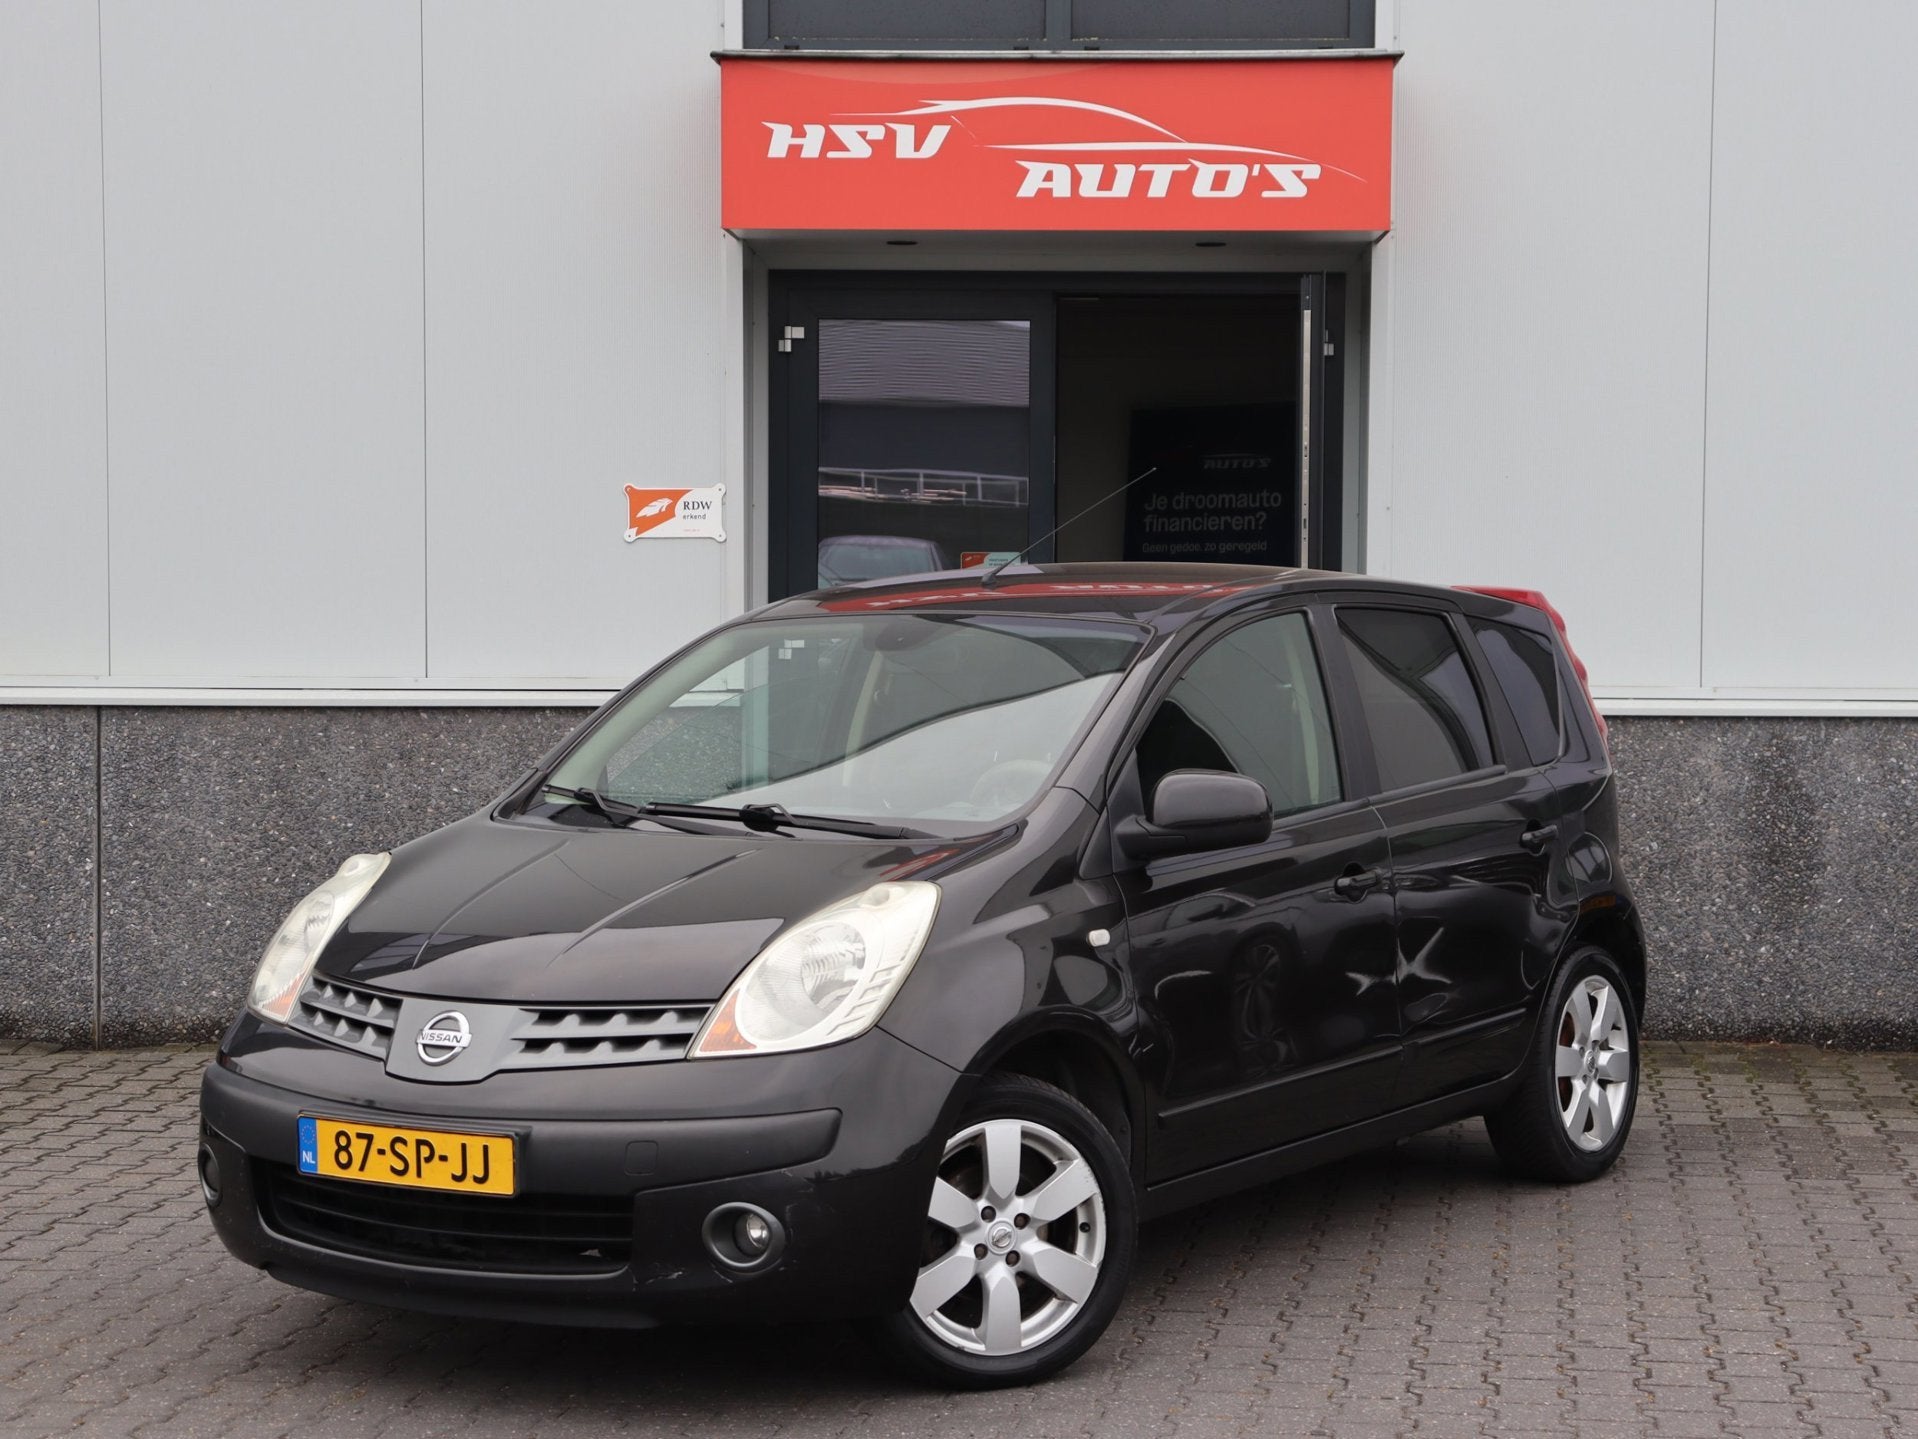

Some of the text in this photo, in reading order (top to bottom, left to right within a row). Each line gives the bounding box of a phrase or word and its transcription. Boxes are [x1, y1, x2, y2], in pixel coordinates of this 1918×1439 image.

[762, 122, 951, 159] HSV
[1015, 158, 1321, 198] AUTO'S
[683, 500, 712, 511] RDW
[1144, 490, 1282, 511] Je droomauto
[1143, 512, 1267, 532] financieren?
[1142, 542, 1167, 553] Geen
[1204, 543, 1216, 552] zo
[1218, 540, 1267, 553] geregeld
[419, 1029, 462, 1044] NISSAN
[302, 1151, 316, 1165] NL
[333, 1130, 490, 1185] 87-SP-JJ
